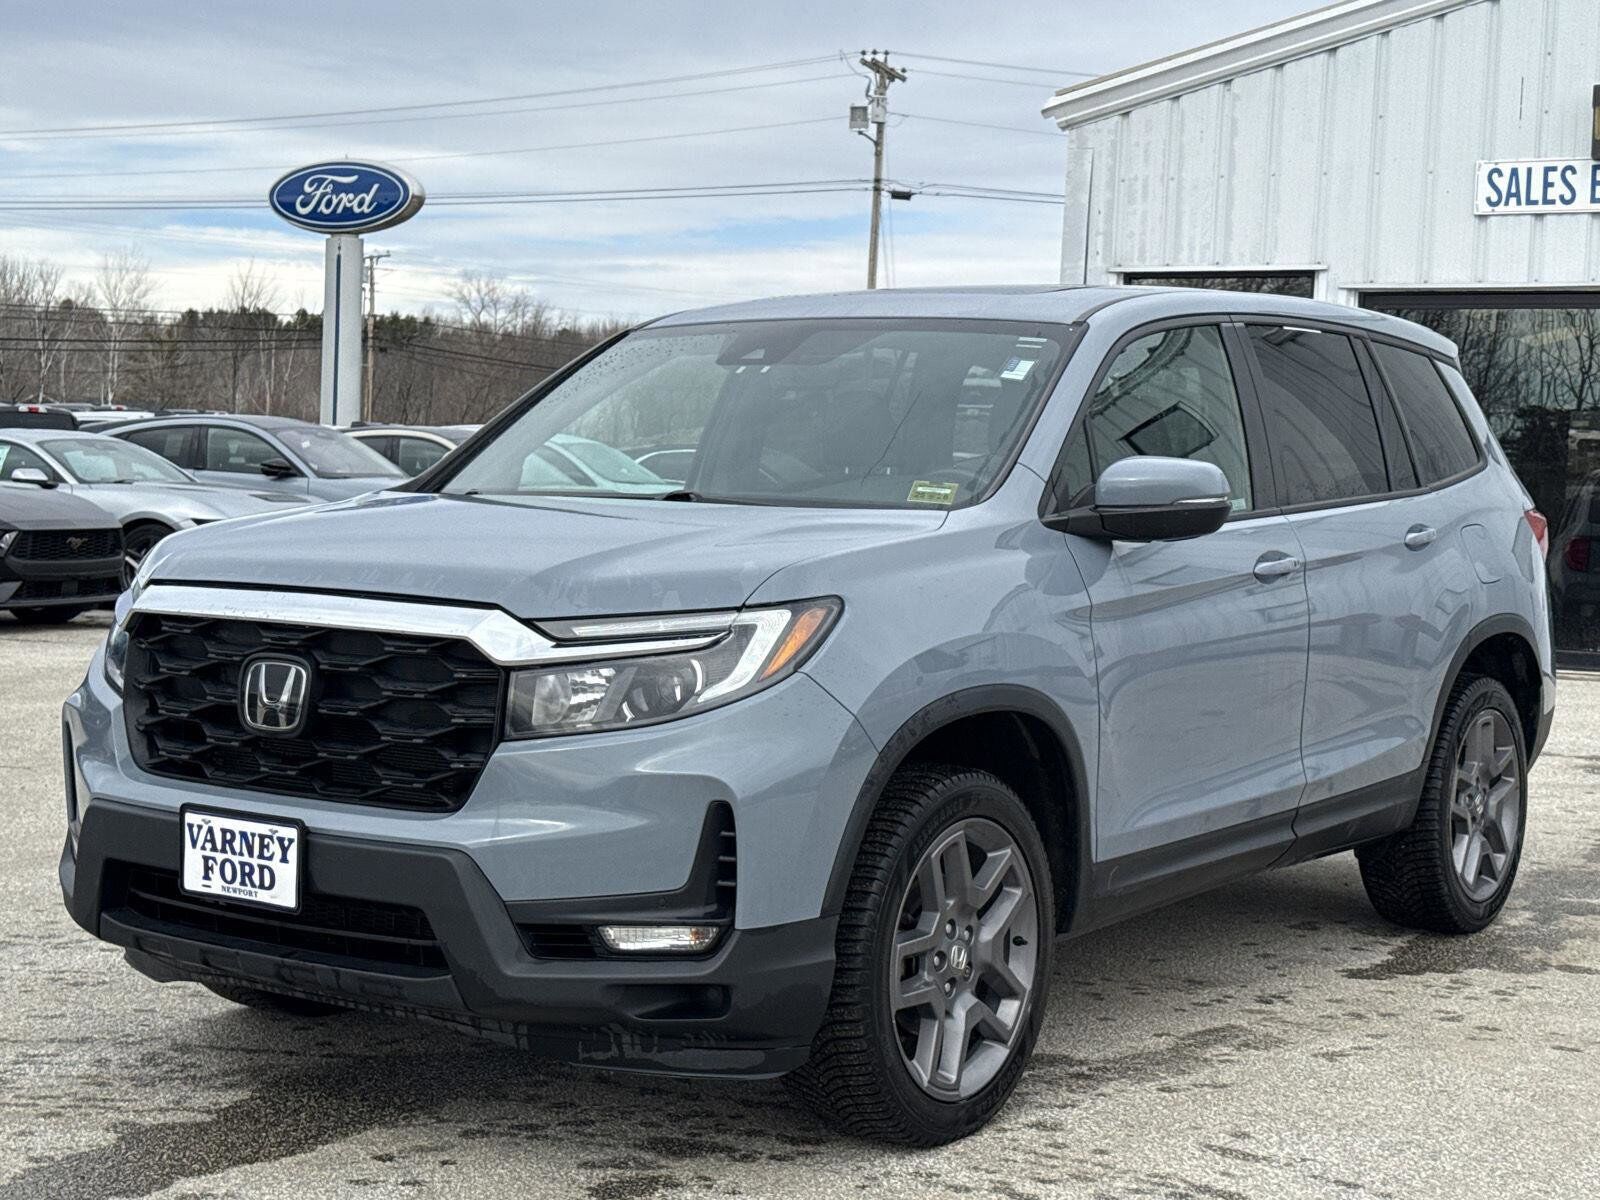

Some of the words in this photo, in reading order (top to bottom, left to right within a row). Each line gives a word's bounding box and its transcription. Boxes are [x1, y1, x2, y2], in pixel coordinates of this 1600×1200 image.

[295, 174, 380, 215] Ford
[1485, 165, 1577, 207] SALES
[187, 822, 295, 864] VARNEY
[201, 854, 276, 891] FORD
[221, 885, 259, 898] NEWPORT
